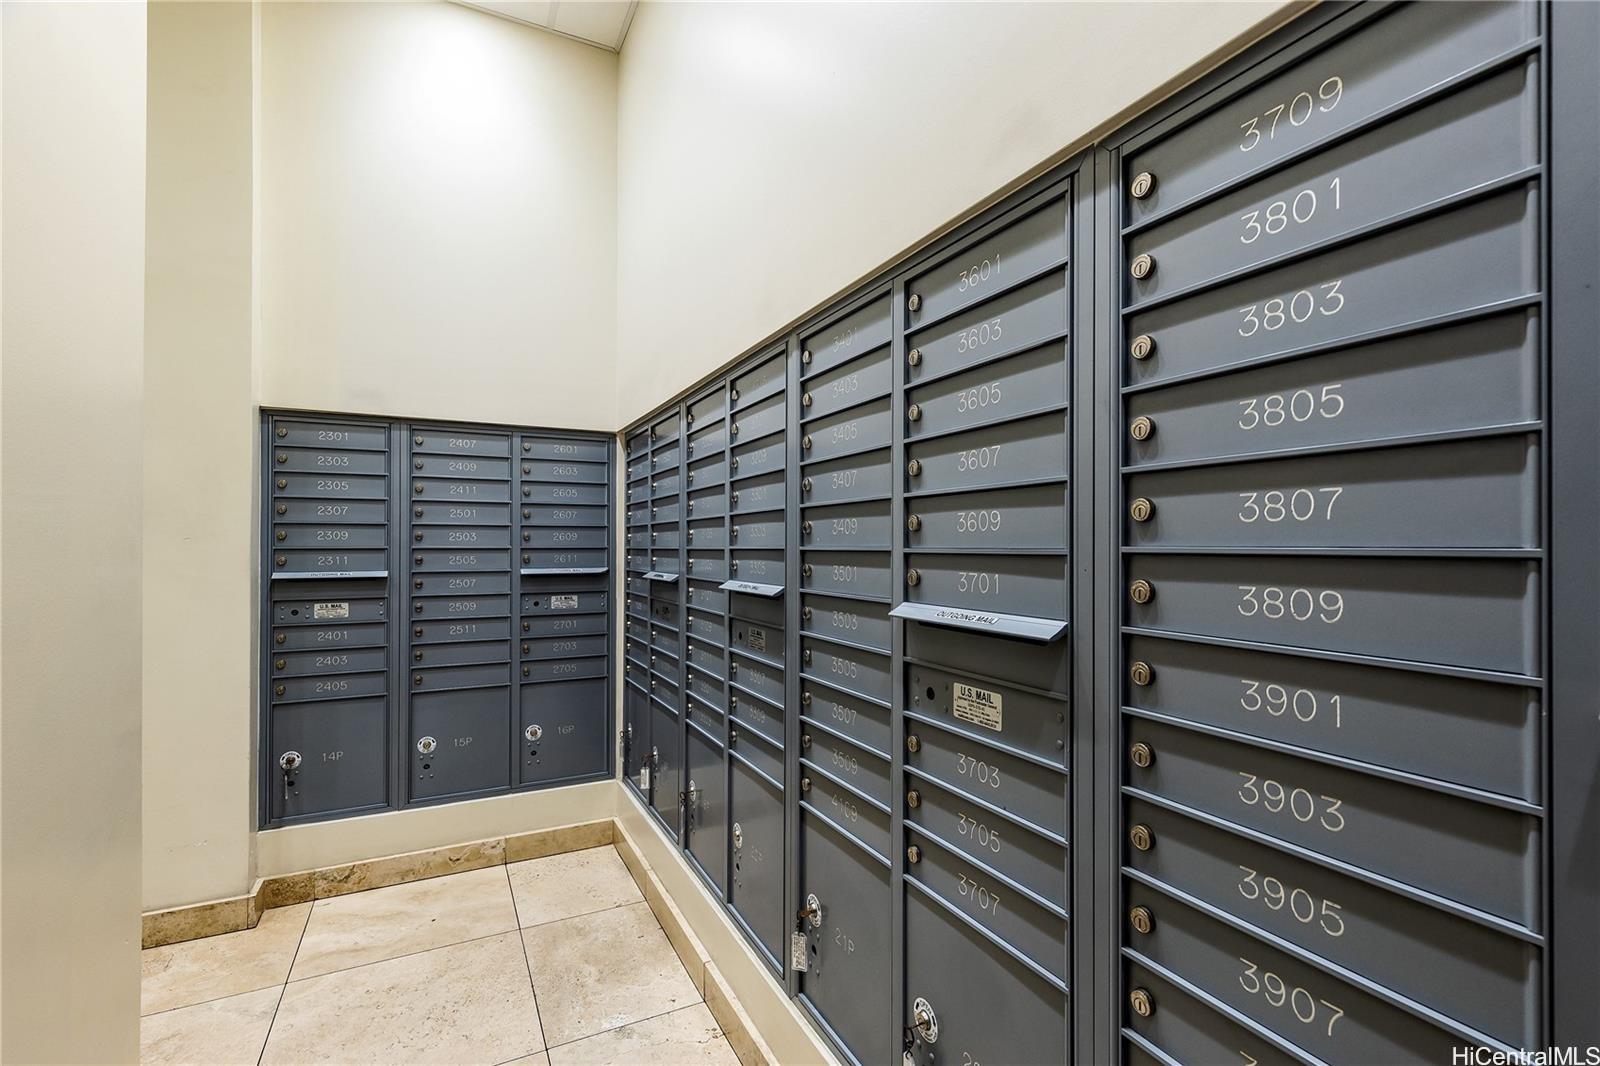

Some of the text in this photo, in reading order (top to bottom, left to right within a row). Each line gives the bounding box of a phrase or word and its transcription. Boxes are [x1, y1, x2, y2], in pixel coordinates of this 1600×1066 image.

[1239, 76, 1344, 152] 3709
[1240, 177, 1341, 244] 3801
[959, 253, 1001, 292] 3601
[1238, 279, 1345, 337] 3803
[958, 319, 1002, 353] 3603
[958, 382, 1002, 413] 3605
[1238, 384, 1345, 430] 3805
[318, 430, 349, 441] 2301
[449, 438, 477, 449] 2407
[553, 445, 578, 454] 2601
[317, 456, 349, 466] 2303
[958, 445, 1001, 472] 3607
[449, 462, 477, 472] 2409
[552, 466, 578, 475] 2603
[317, 480, 349, 490] 2305
[832, 470, 857, 489] 3407
[450, 485, 477, 495] 2411
[552, 489, 578, 497] 2605
[317, 505, 349, 516] 2307
[1239, 487, 1343, 523] 3807
[450, 509, 477, 518] 2501
[553, 511, 577, 519] 2607
[832, 518, 858, 535] 3409
[956, 510, 1001, 533] 3609
[317, 530, 349, 540] 2309
[449, 532, 477, 541] 2503
[552, 532, 578, 541] 2609
[317, 556, 349, 566] 2311
[449, 556, 477, 565] 2505
[553, 554, 577, 563] 2611
[832, 565, 858, 582] 3501
[449, 579, 477, 588] 2507
[958, 571, 999, 595] 3701
[449, 602, 477, 611] 2509
[1237, 586, 1344, 624] 3809
[832, 610, 858, 630] 3503
[936, 611, 996, 624] OUTGOING MAIL
[450, 625, 477, 635] 2511
[553, 620, 577, 629] 2701
[317, 631, 349, 641] 2401
[553, 642, 577, 651] 2703
[316, 655, 348, 667] 2403
[553, 664, 577, 673] 2705
[831, 656, 857, 679] 3505
[316, 681, 348, 692] 2405
[960, 685, 994, 705] U.S. MAIL
[1241, 679, 1341, 728] 3901
[831, 702, 857, 726] 3507
[453, 737, 473, 747] 15P
[322, 751, 344, 762] 14P
[832, 747, 858, 775] 3509
[957, 752, 1001, 789] 3703
[1238, 771, 1345, 832] 3903
[957, 812, 1001, 853] 3705
[957, 872, 1000, 916] 3707
[1238, 865, 1345, 937] 3905
[833, 927, 855, 953] 21P
[1239, 957, 1344, 1037] 3907
